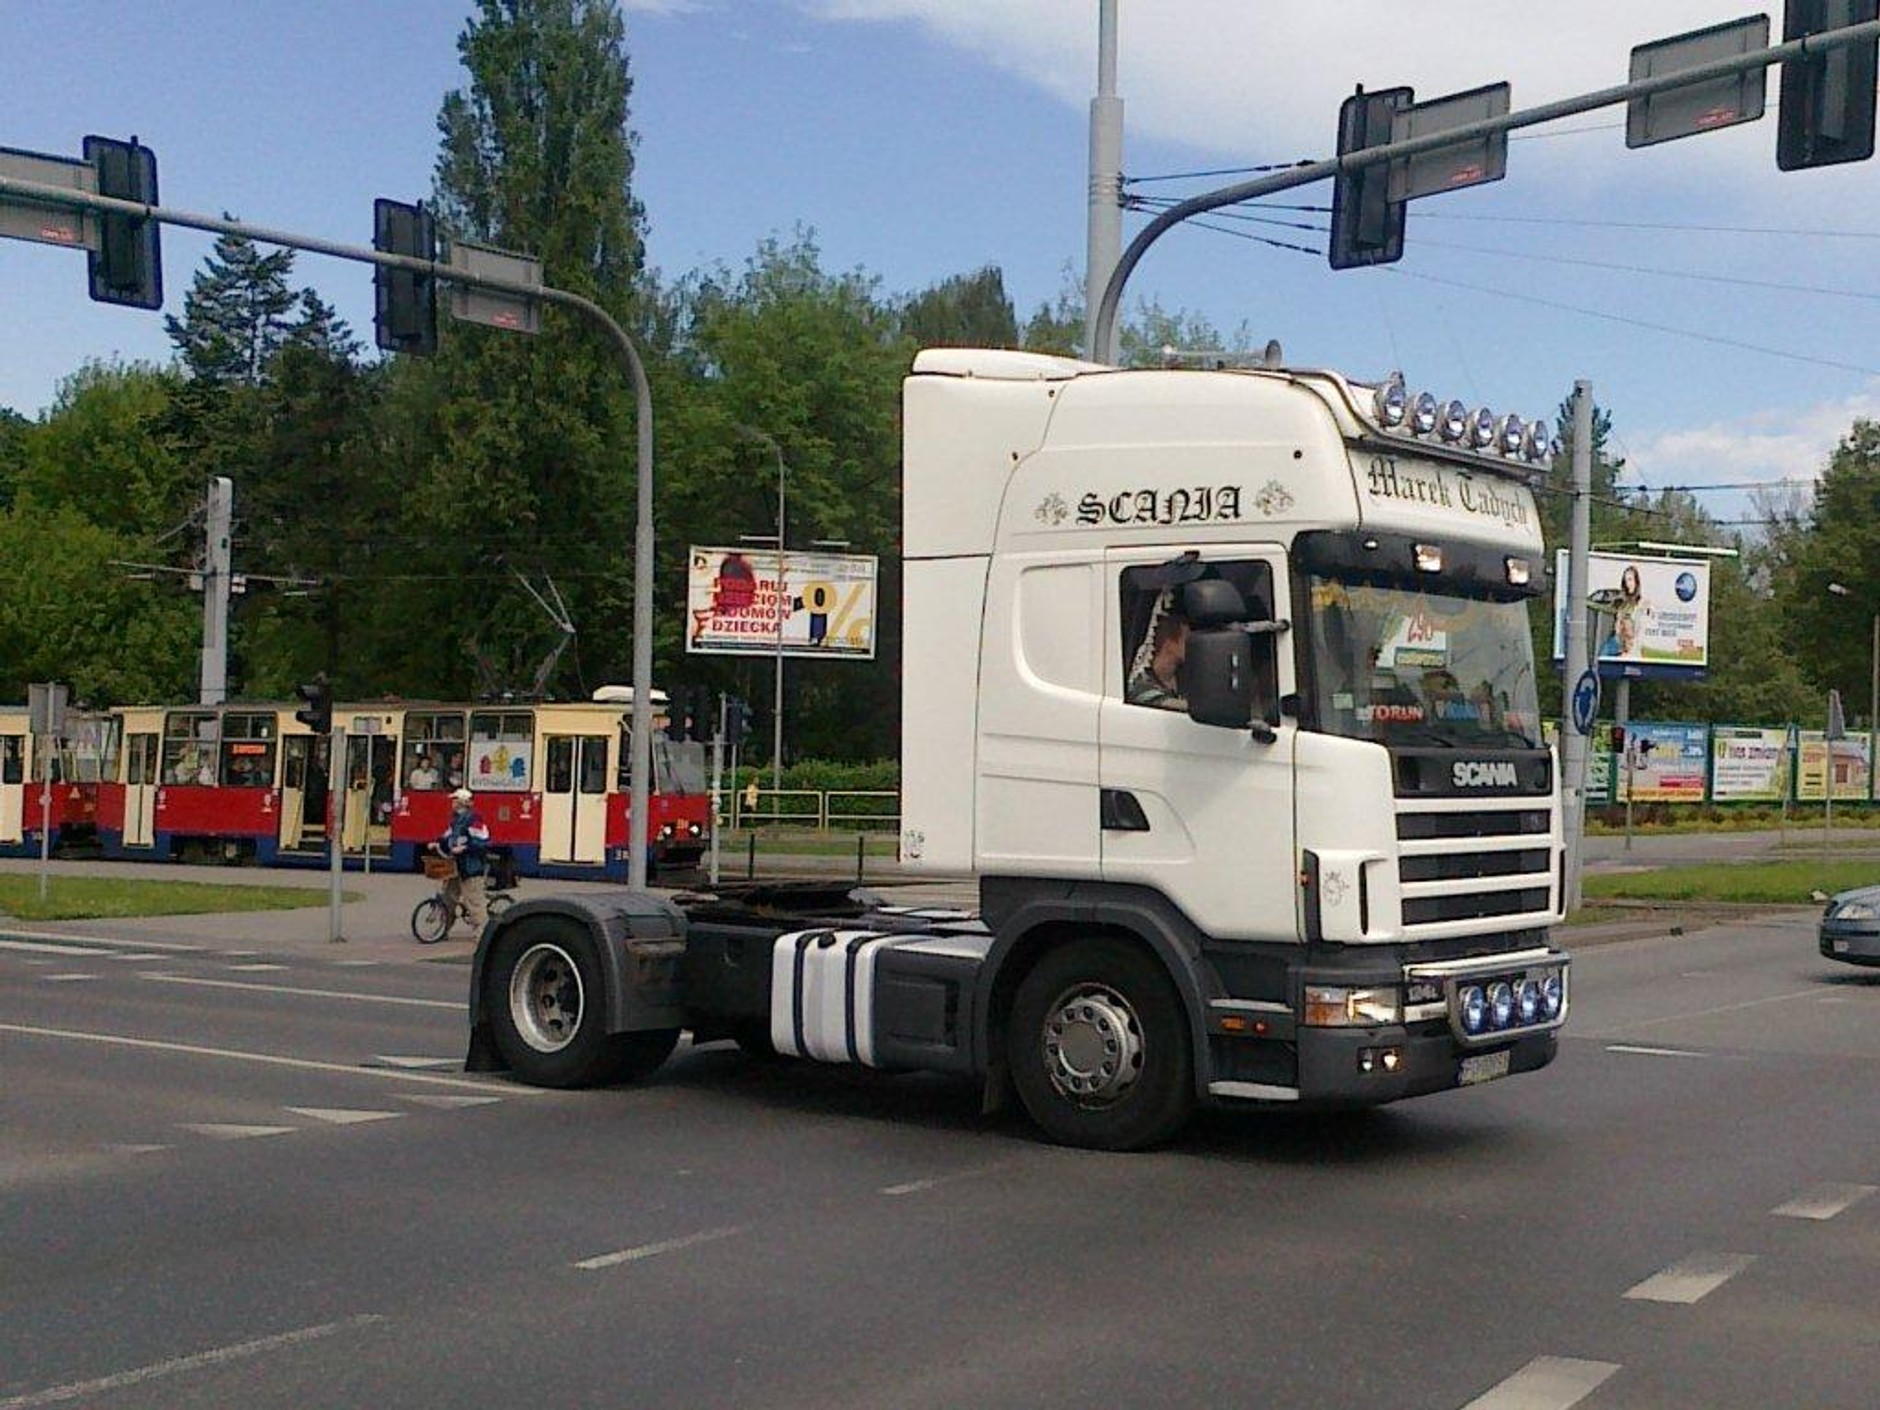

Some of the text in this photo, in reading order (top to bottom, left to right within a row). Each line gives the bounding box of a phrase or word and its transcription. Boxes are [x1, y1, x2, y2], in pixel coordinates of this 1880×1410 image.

[1368, 456, 1452, 507] Marek
[1076, 486, 1241, 525] SCANIA
[712, 620, 782, 634] DZIECKA
[1452, 762, 1518, 787] SCANIA
